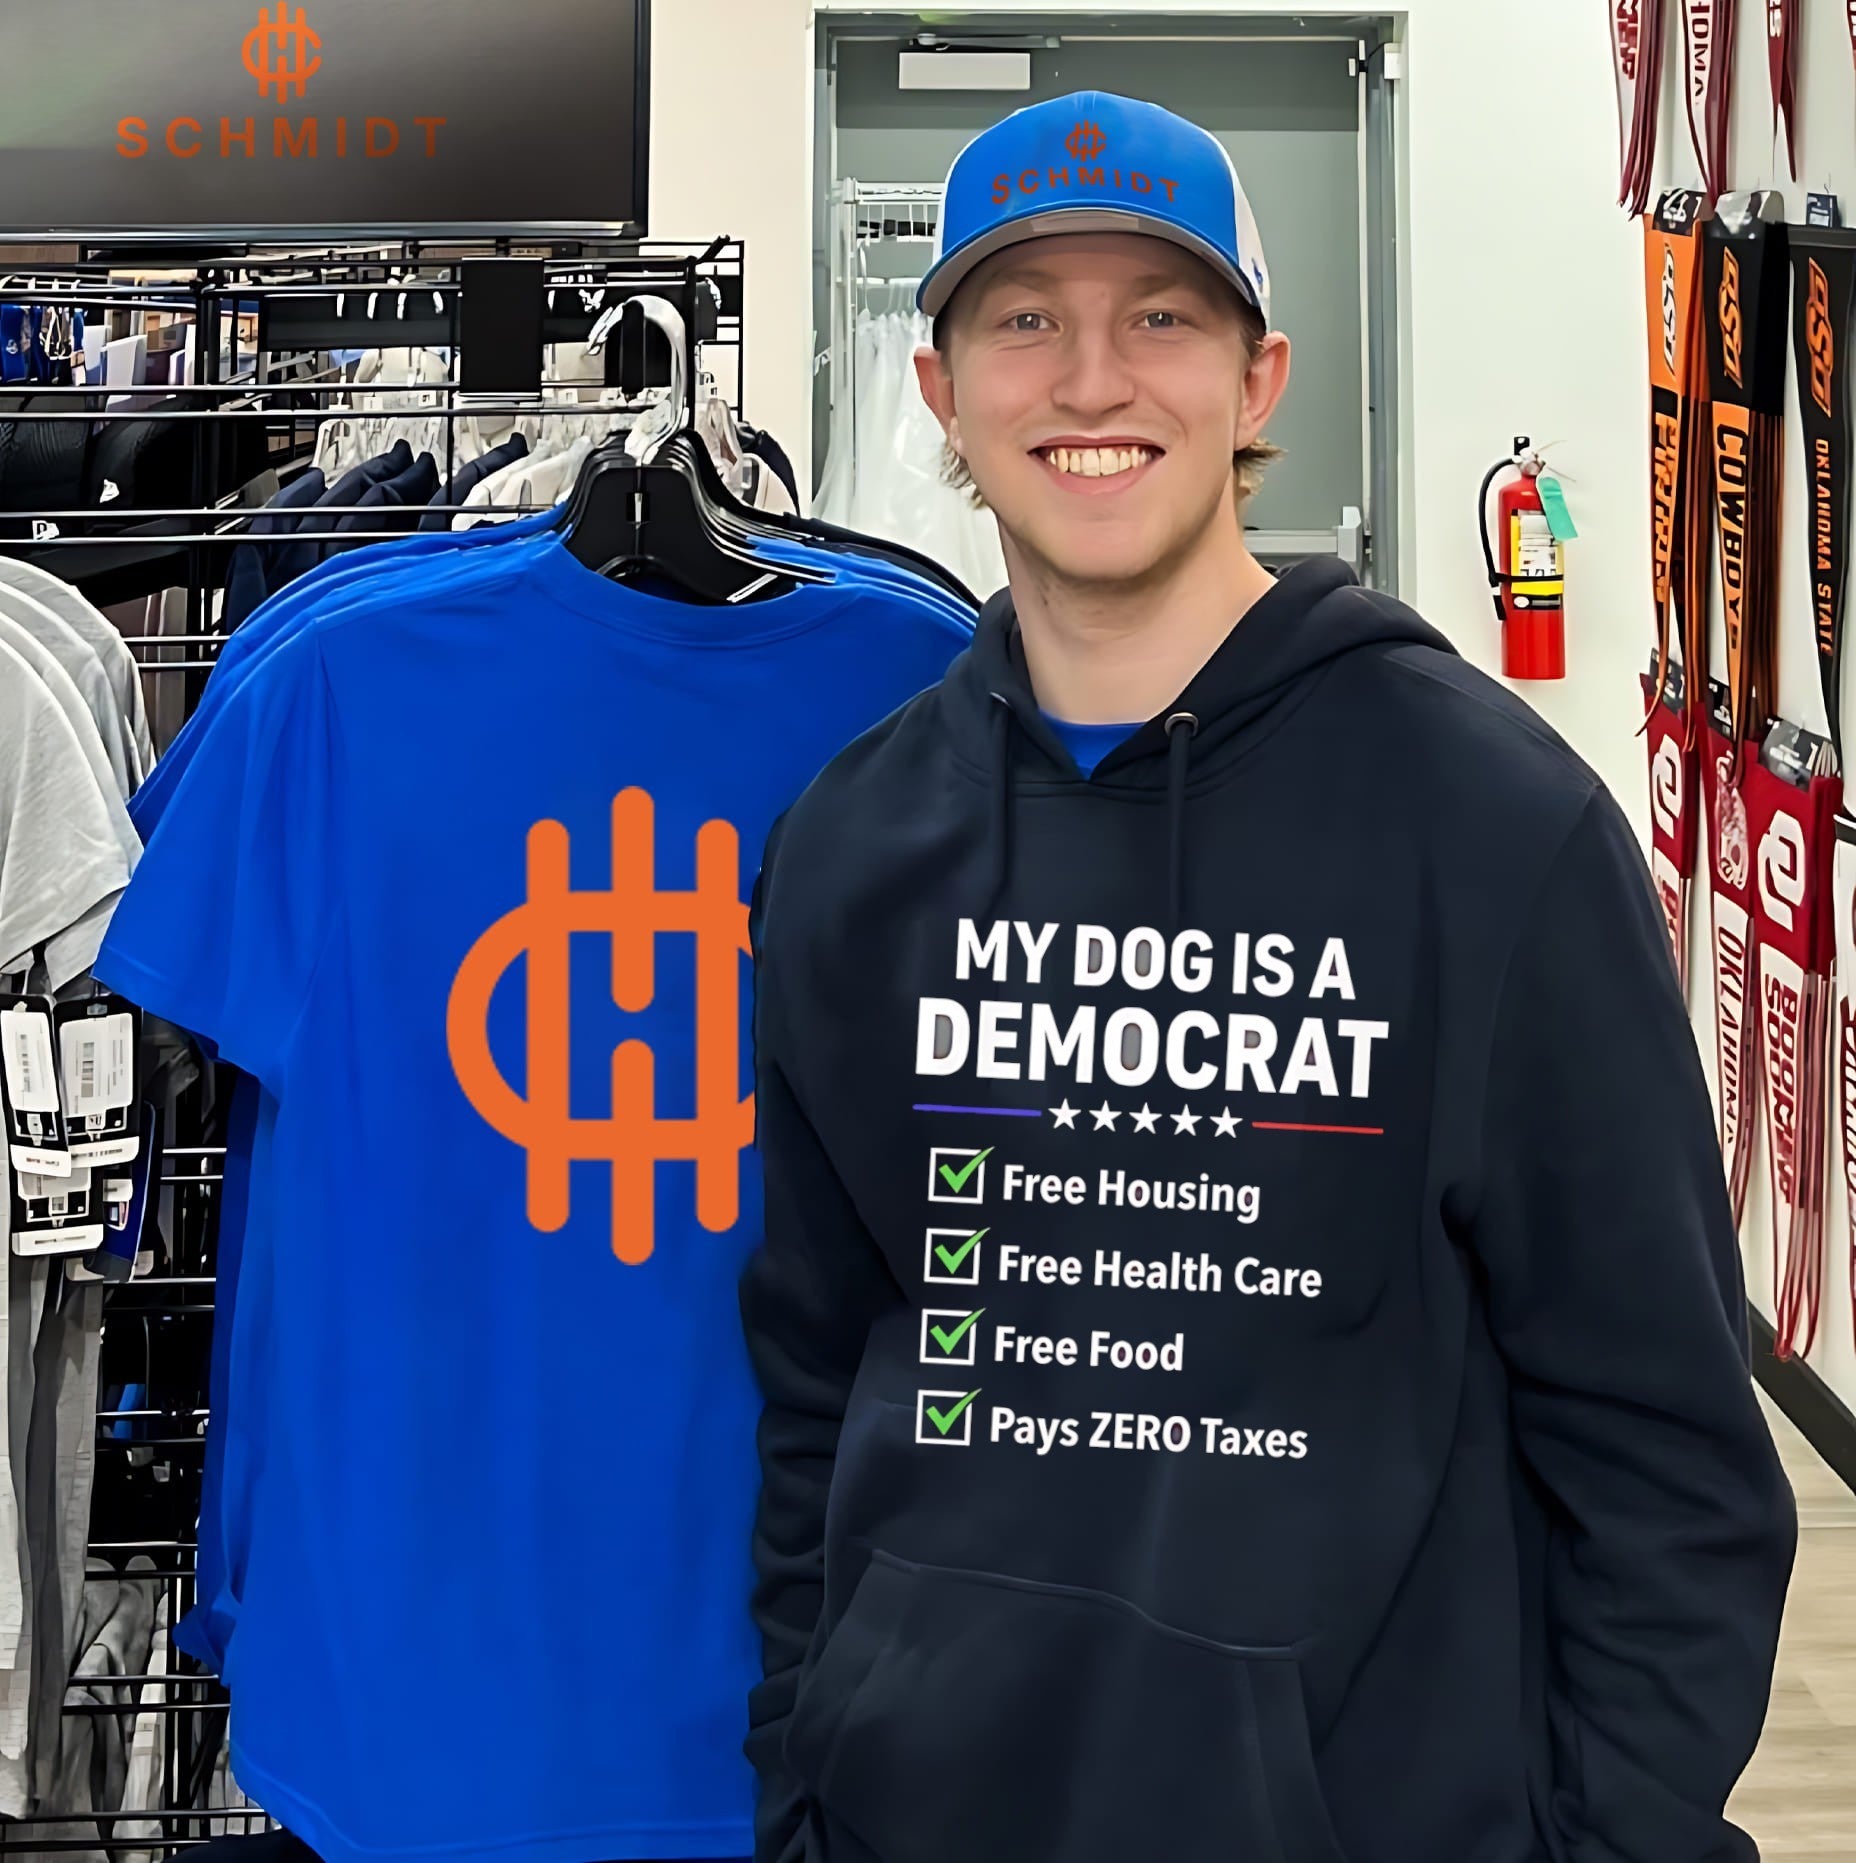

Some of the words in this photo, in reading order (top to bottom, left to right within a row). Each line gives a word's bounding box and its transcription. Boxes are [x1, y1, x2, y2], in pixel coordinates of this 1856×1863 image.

[117, 116, 448, 159] SCHMIDT
[991, 166, 1179, 204] SCHMIDT
[1815, 438, 1833, 570] OKLAHOMA
[1816, 583, 1834, 656] STATE
[955, 917, 1060, 984] MY
[1073, 923, 1214, 993] DOG
[1232, 932, 1295, 998] IS
[1308, 937, 1356, 1000] A
[915, 996, 1390, 1099] DEMOCRAT
[1717, 926, 1745, 1144] OKLAHOMA
[1003, 1164, 1087, 1205] Free
[1098, 1169, 1261, 1225] Housing
[998, 1244, 1083, 1286] Free
[1093, 1249, 1222, 1293] Health
[1234, 1256, 1323, 1298] Care
[994, 1325, 1078, 1366] Free
[1089, 1330, 1185, 1372] Food
[990, 1406, 1080, 1456] Pays
[1088, 1411, 1192, 1453] ZERO
[1199, 1417, 1308, 1459] Taxes
